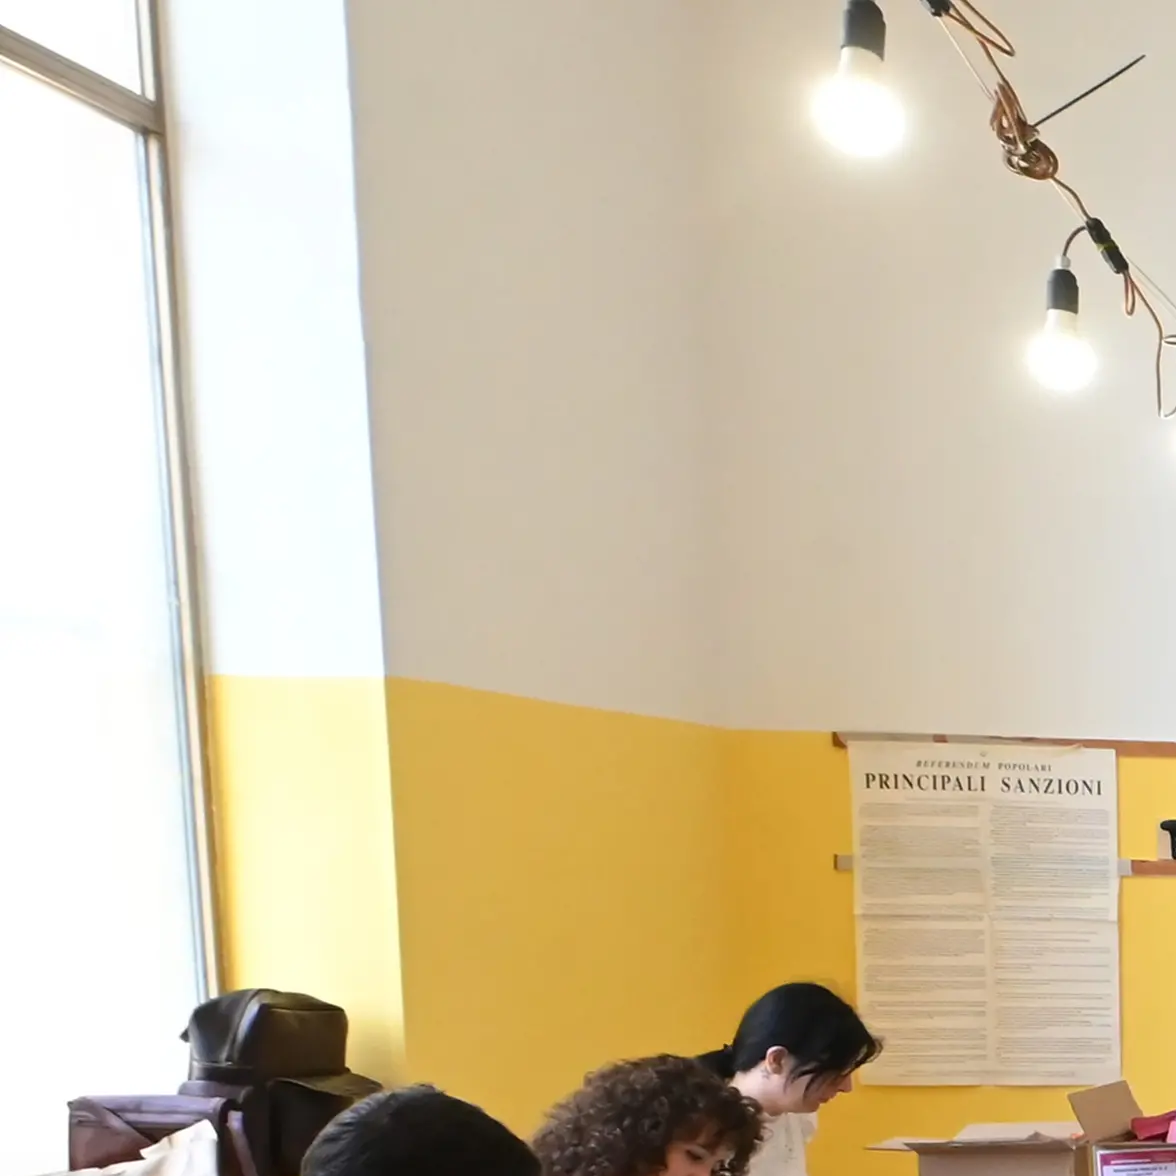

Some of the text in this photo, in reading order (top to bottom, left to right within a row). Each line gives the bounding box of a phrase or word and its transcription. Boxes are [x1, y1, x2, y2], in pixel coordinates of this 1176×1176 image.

[916, 760, 1052, 772] REFERENDUM POPOLARI
[864, 773, 1103, 796] PRINCIPALI SANZIONI
